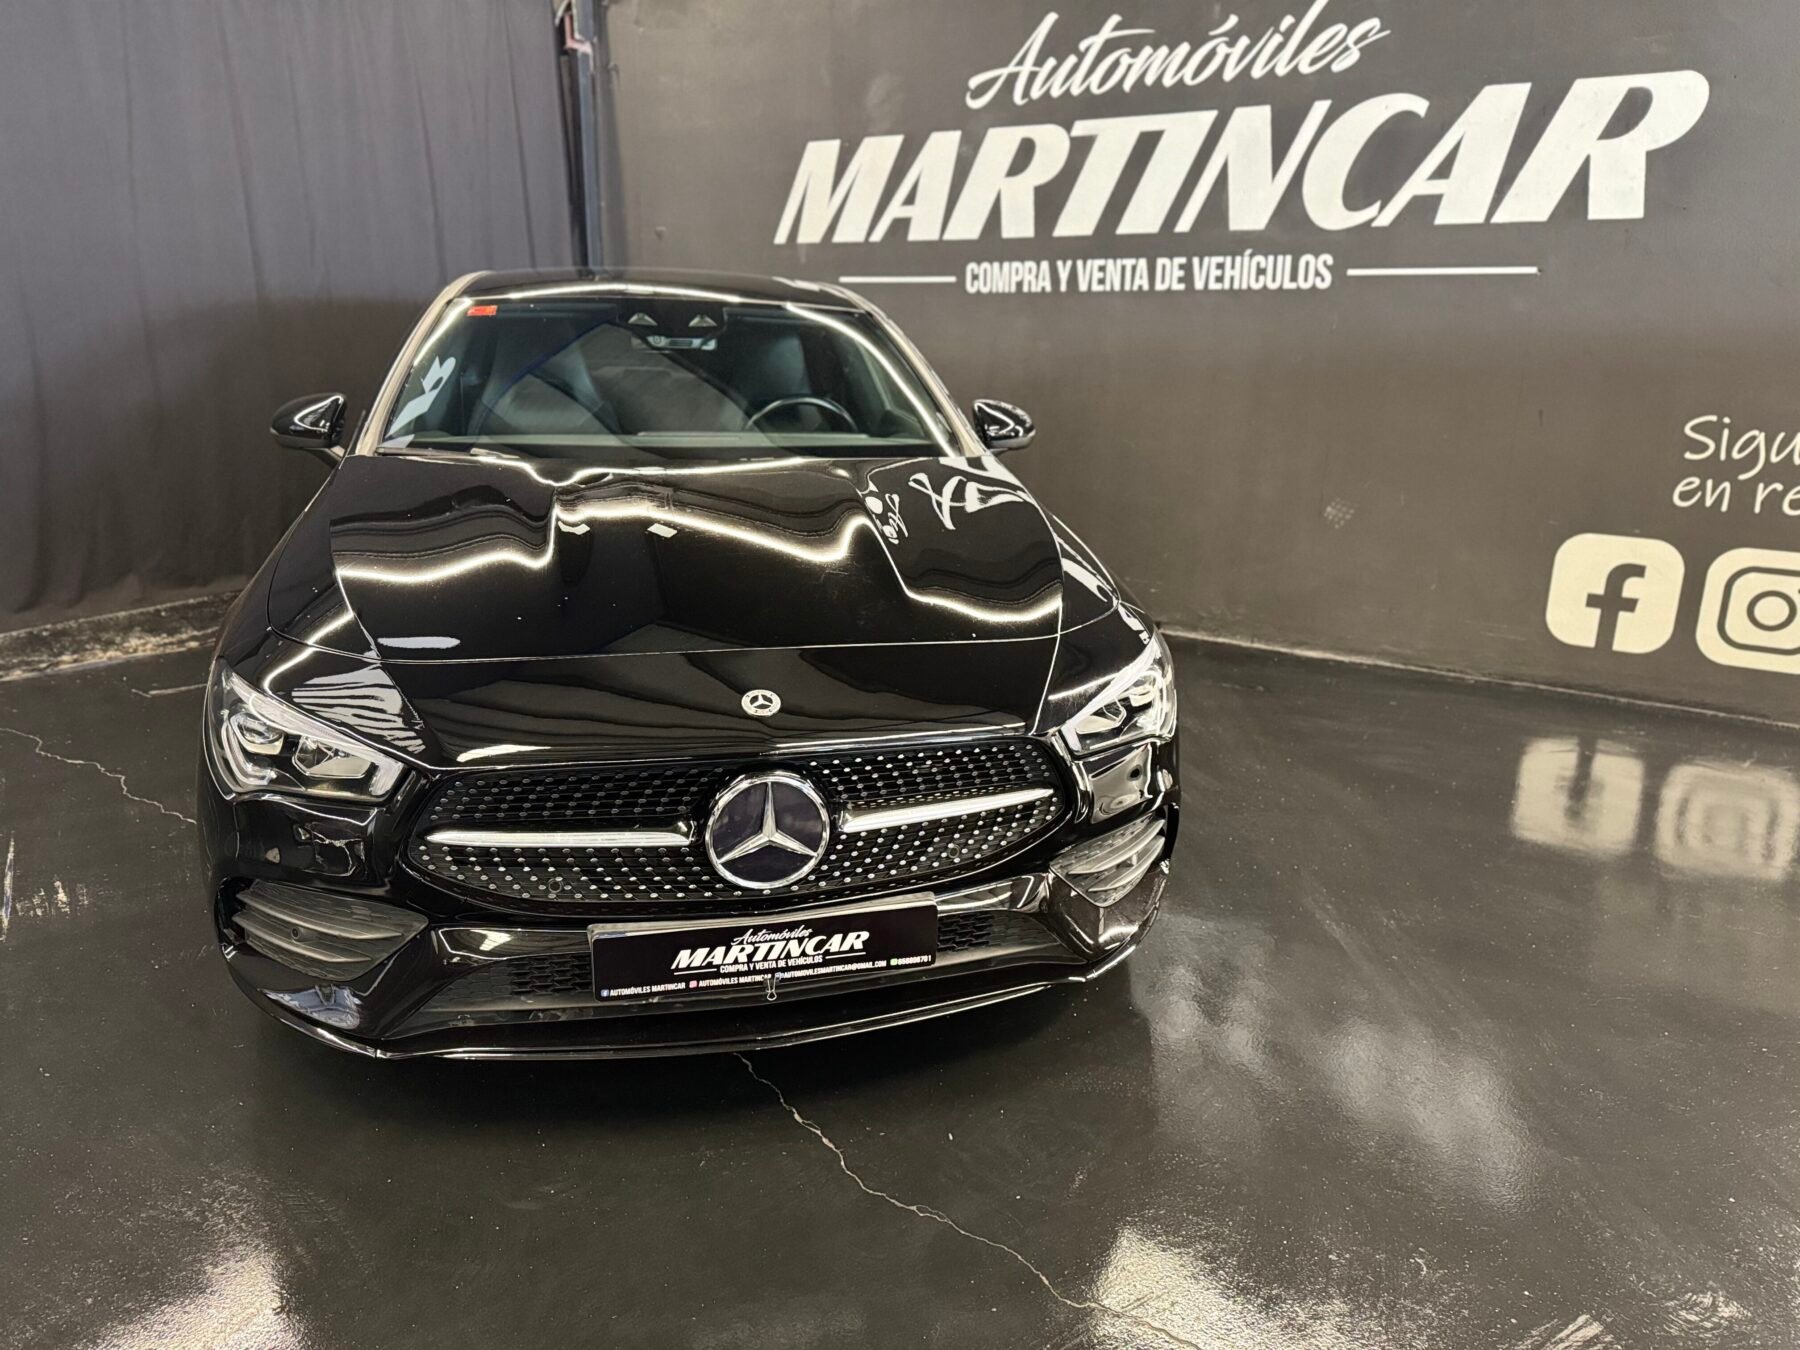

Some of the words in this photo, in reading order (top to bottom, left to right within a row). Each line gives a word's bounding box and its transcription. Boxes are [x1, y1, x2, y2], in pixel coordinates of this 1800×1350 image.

[965, 0, 1391, 110] Automóviles
[773, 69, 1711, 246] MARTINCAR
[965, 261, 1052, 294] COMPRA
[1056, 260, 1073, 292] Y
[1076, 257, 1150, 292] VENTA
[1154, 257, 1188, 291] DE
[1192, 249, 1334, 290] VEHÍCULOS
[1683, 414, 1800, 481] Sigu
[1672, 476, 1732, 513] en
[1753, 482, 1800, 516] re
[670, 931, 870, 970] MARTINCAR
[731, 925, 813, 946] Automóviles
[720, 962, 749, 973] COMPRA
[750, 961, 755, 971] Y
[755, 960, 777, 971] VENTA
[778, 958, 787, 968] DE
[787, 955, 823, 968] VEHÍCULOS
[651, 982, 686, 993] MARTINCAR
